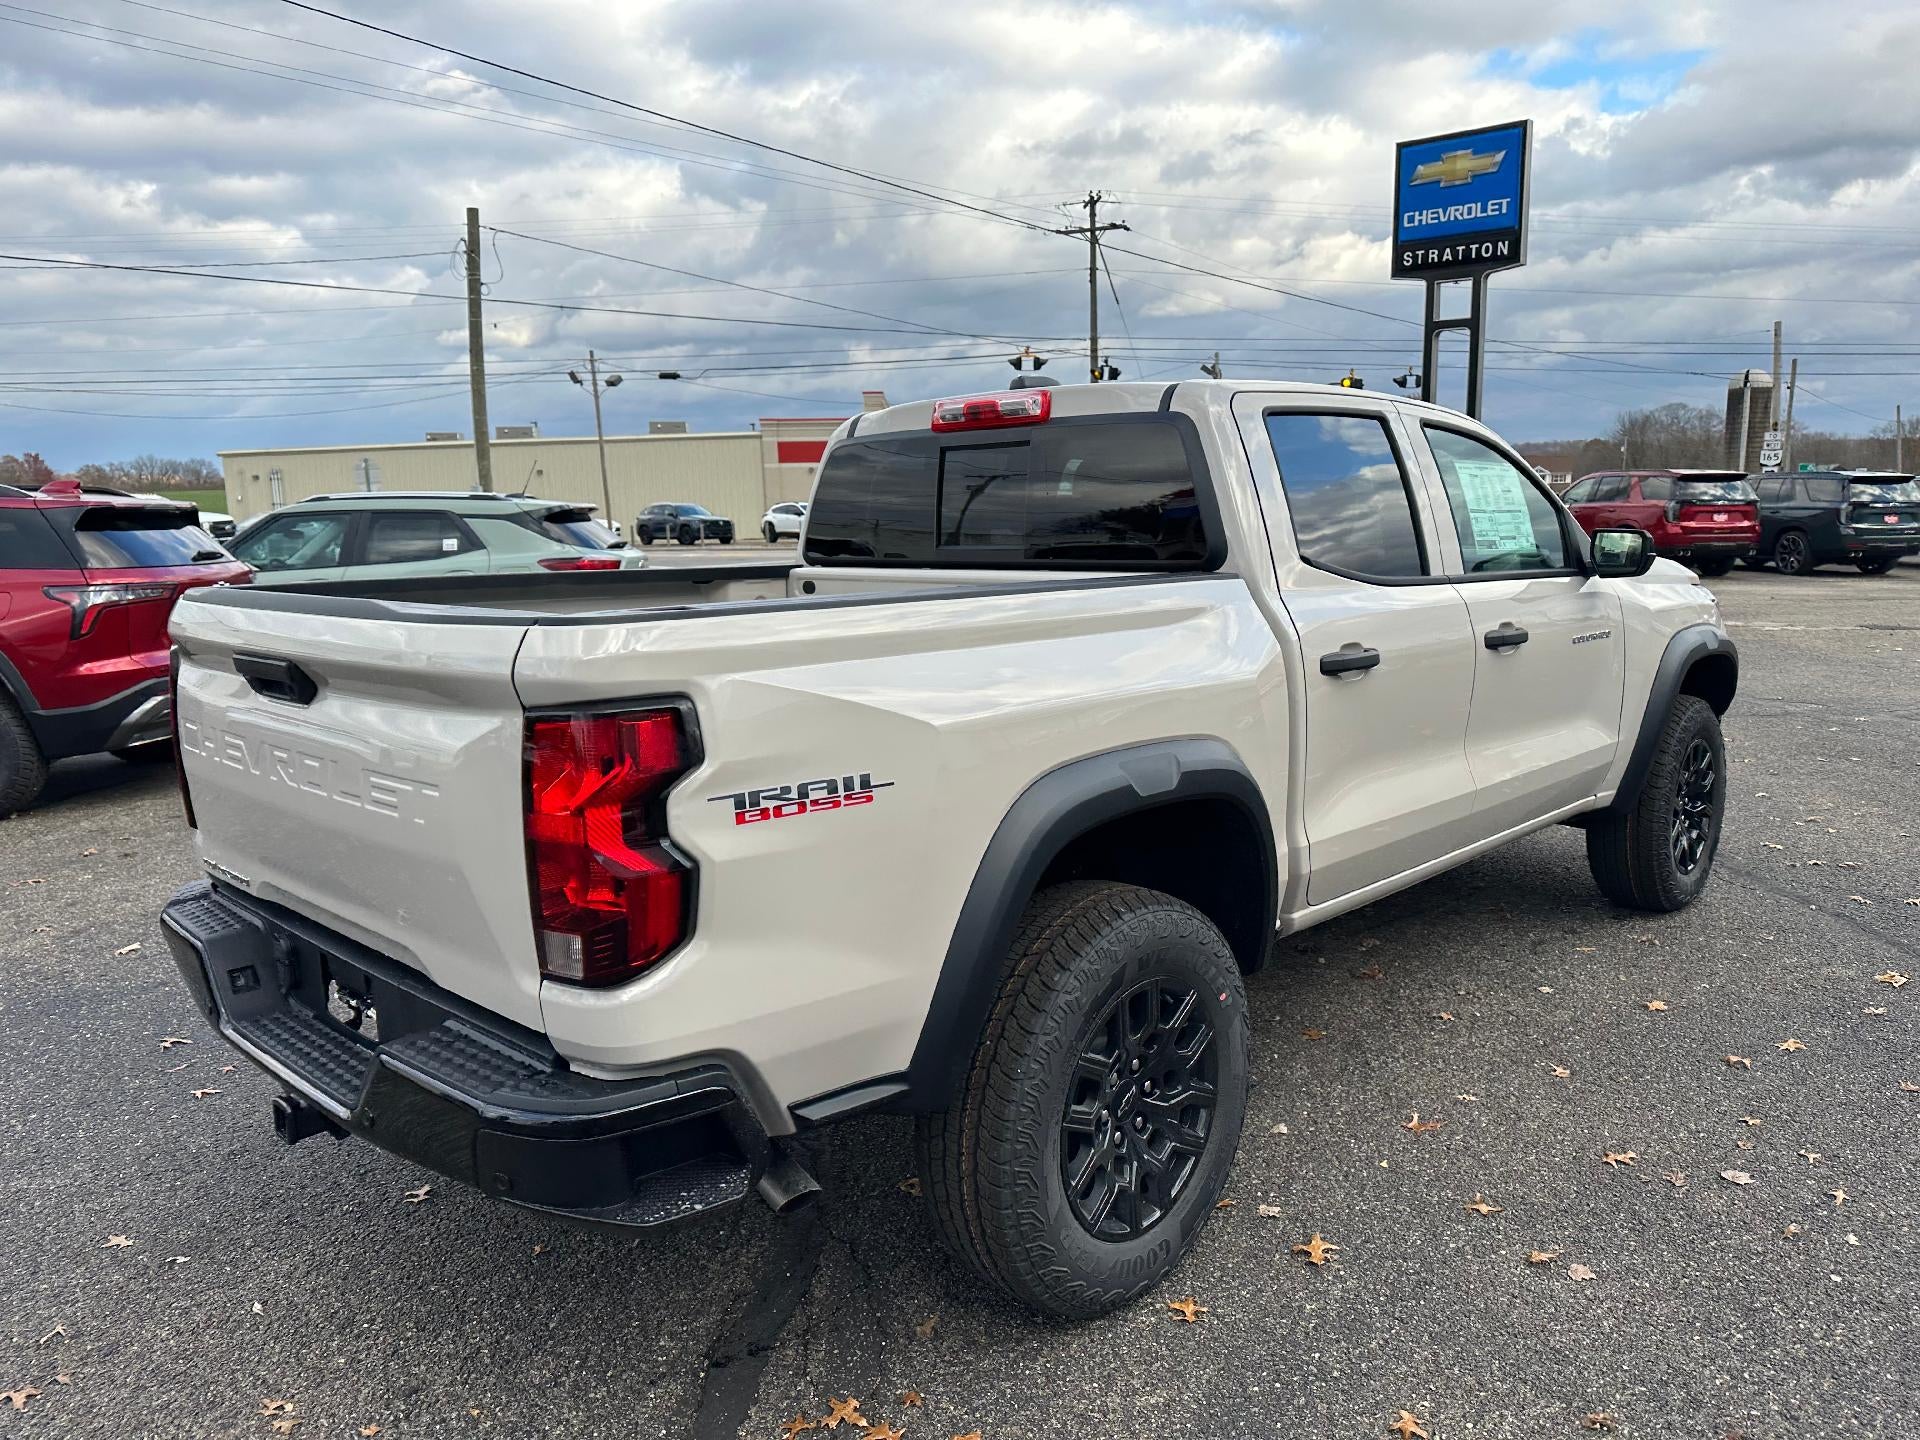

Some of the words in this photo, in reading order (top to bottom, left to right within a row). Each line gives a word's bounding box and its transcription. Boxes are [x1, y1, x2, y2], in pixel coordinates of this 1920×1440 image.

[1403, 198, 1511, 228] CHEVROLET
[1403, 240, 1509, 266] STRATTON
[1763, 453, 1780, 461] 165
[181, 718, 439, 824] CHEVROLET
[707, 773, 895, 811] TRAIL
[735, 790, 874, 826] BOSS
